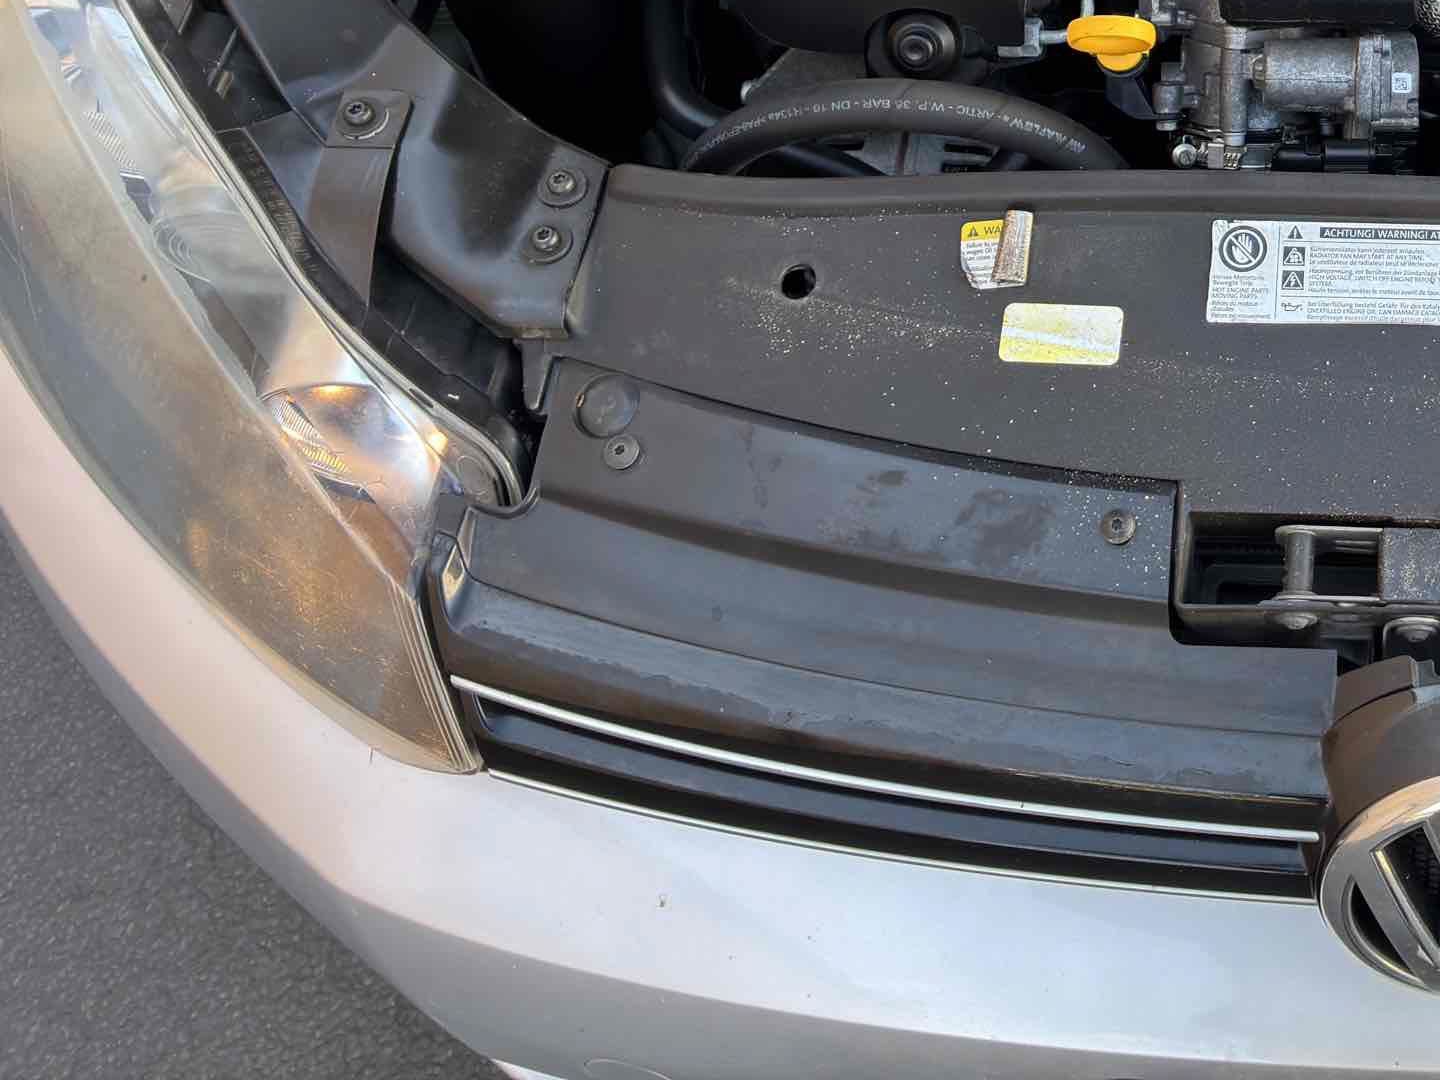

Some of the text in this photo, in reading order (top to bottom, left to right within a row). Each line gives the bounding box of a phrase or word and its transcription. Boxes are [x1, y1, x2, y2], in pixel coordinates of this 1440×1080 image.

[831, 99, 850, 112] DN
[863, 98, 891, 110] BAR
[1323, 228, 1375, 239] ACHTUNG!
[1378, 229, 1428, 240] WARNING!
